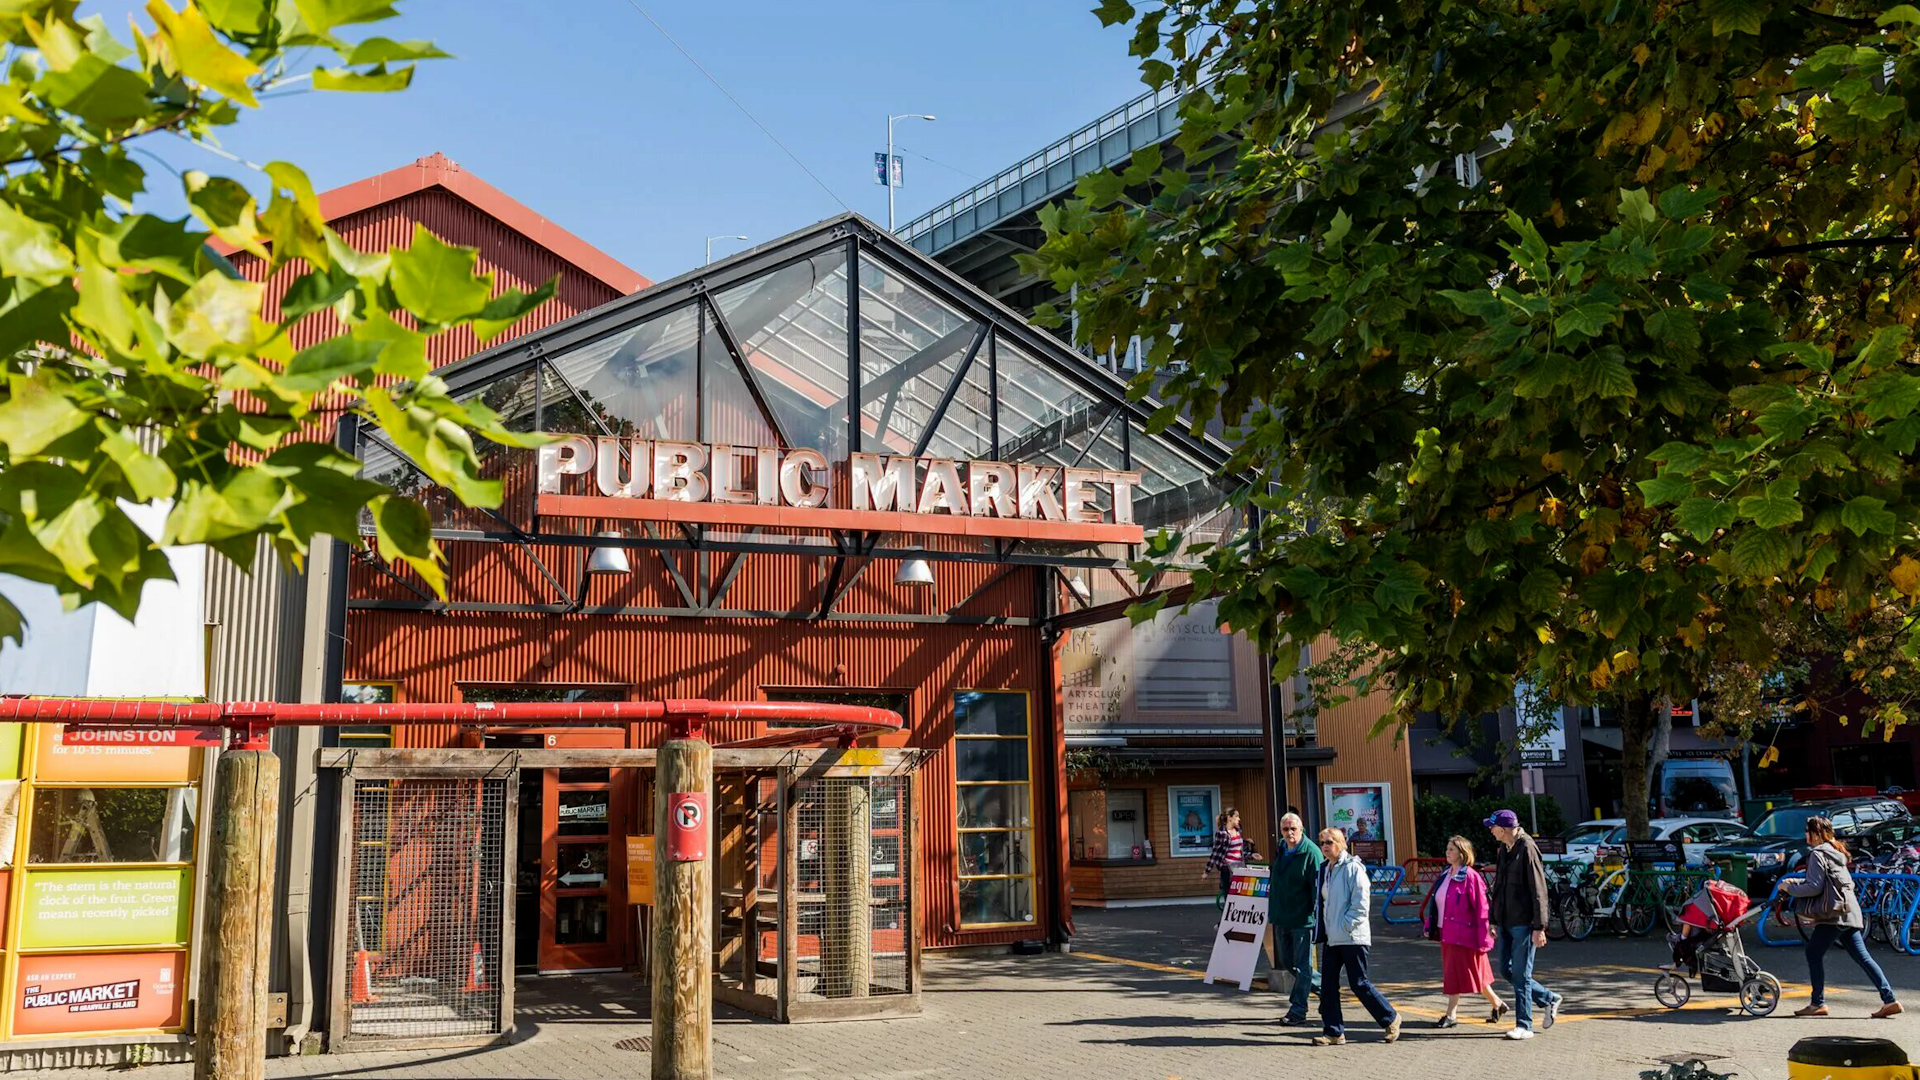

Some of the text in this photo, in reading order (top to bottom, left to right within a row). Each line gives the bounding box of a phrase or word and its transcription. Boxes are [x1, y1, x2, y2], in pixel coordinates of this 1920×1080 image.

[539, 433, 1141, 525] PUBLIC MARKET
[1162, 624, 1221, 634] ARTSCLU
[1068, 690, 1120, 698] ARTSCLUB
[1068, 702, 1121, 710] THEATRE
[1069, 714, 1121, 722] COMPANY
[69, 729, 176, 743] JOHNSTON
[548, 735, 556, 746] 6
[52, 745, 67, 755] for
[72, 746, 101, 754] 10-15
[577, 804, 605, 813] MARKET
[67, 882, 95, 891] stem
[100, 881, 108, 890] is
[113, 880, 131, 890] the
[134, 879, 176, 890] natural
[1230, 880, 1270, 893] aquabus
[39, 893, 177, 905] clock of the fruit. Green
[38, 910, 78, 919] means
[82, 907, 128, 919] recently
[1224, 901, 1265, 925] Ferries
[26, 974, 40, 982] ASK
[24, 981, 138, 1008] PUBLIC MARKET
[25, 986, 40, 994] THE
[79, 1003, 111, 1011] GRANVILLE
[112, 1000, 136, 1009] ISLAND
